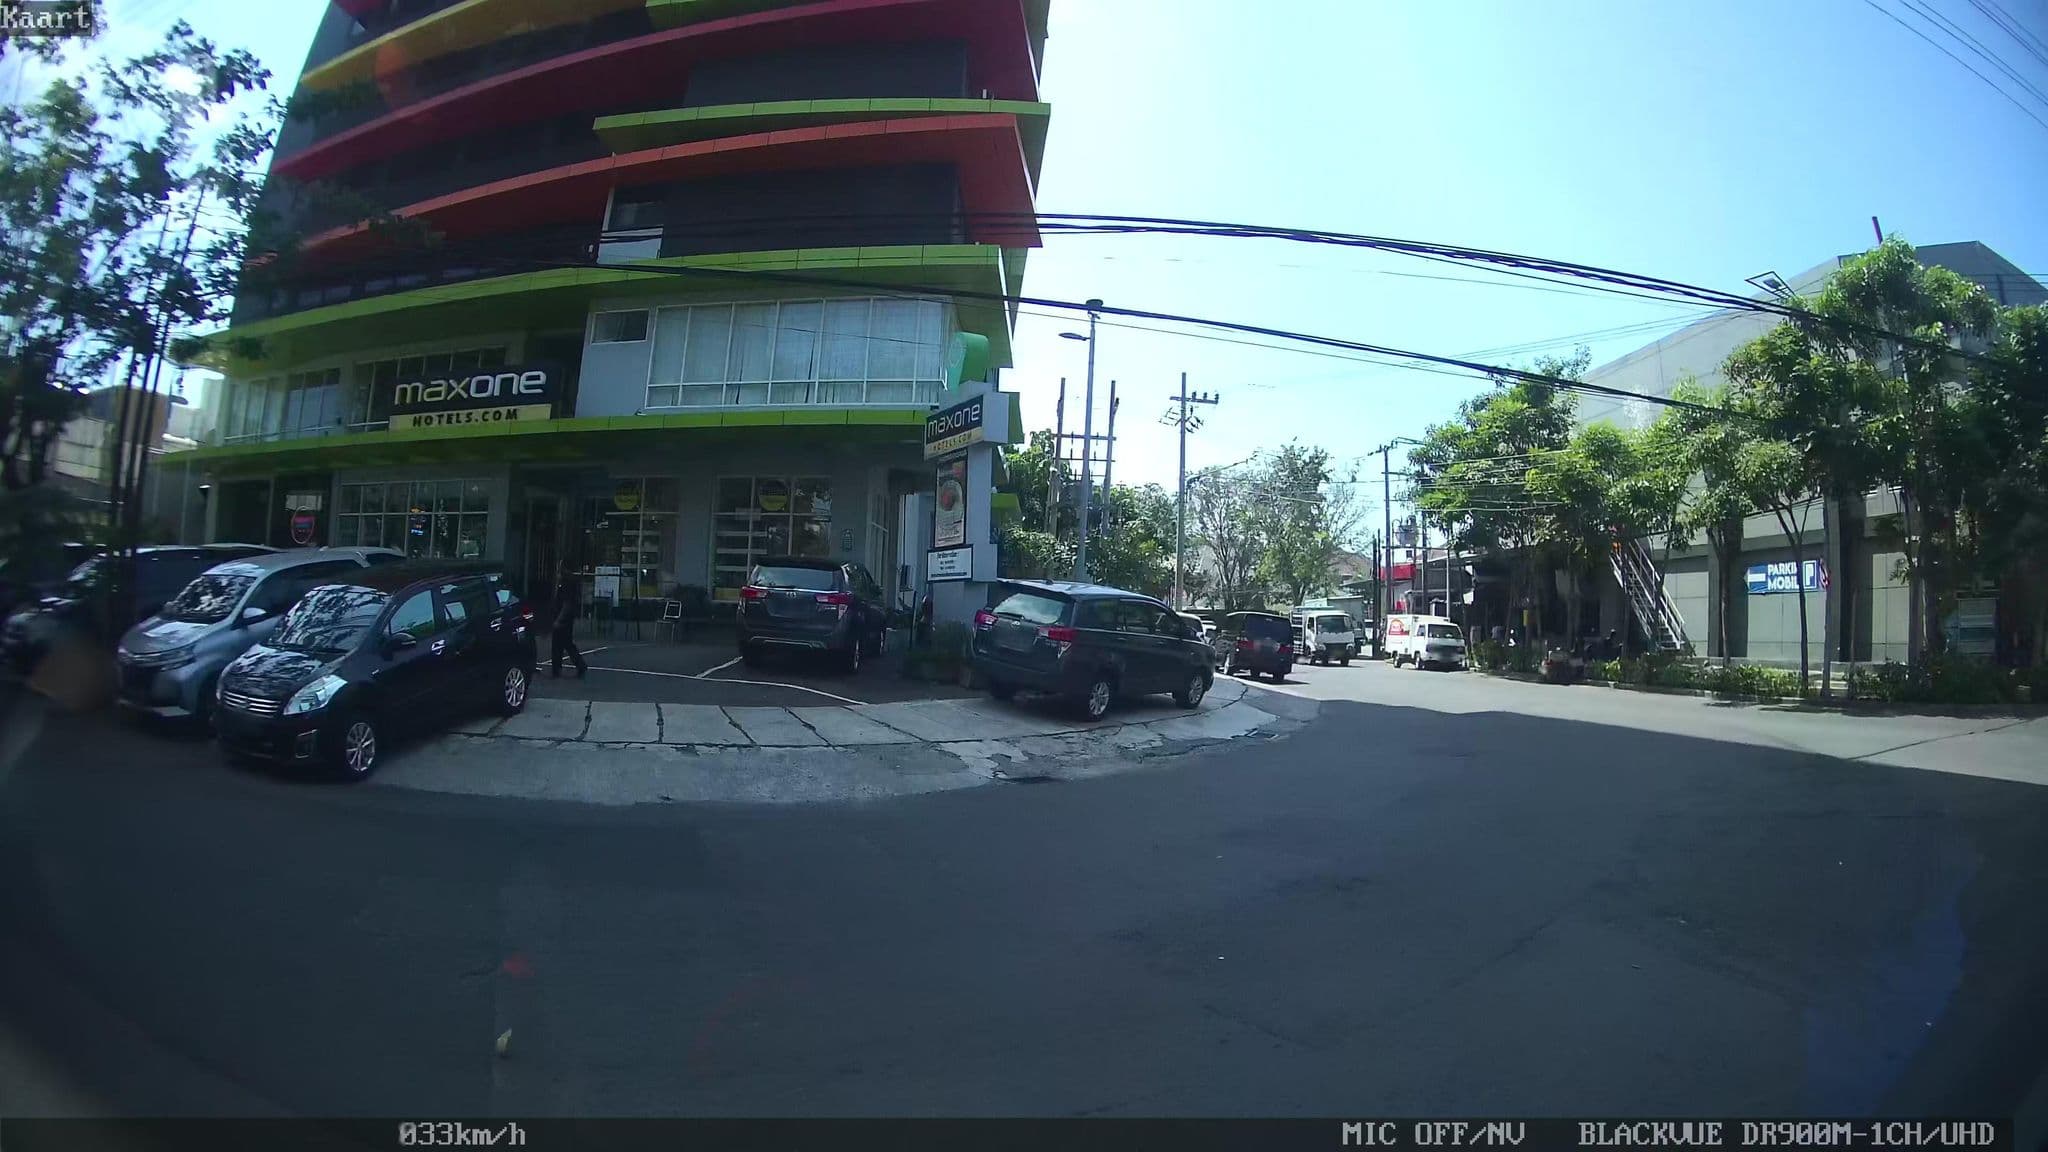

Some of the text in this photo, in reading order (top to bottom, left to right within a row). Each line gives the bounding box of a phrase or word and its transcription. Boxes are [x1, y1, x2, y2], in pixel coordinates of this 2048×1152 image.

[394, 370, 547, 406] maxone
[412, 408, 518, 428] HOTELS.COM
[927, 403, 981, 438] maxone
